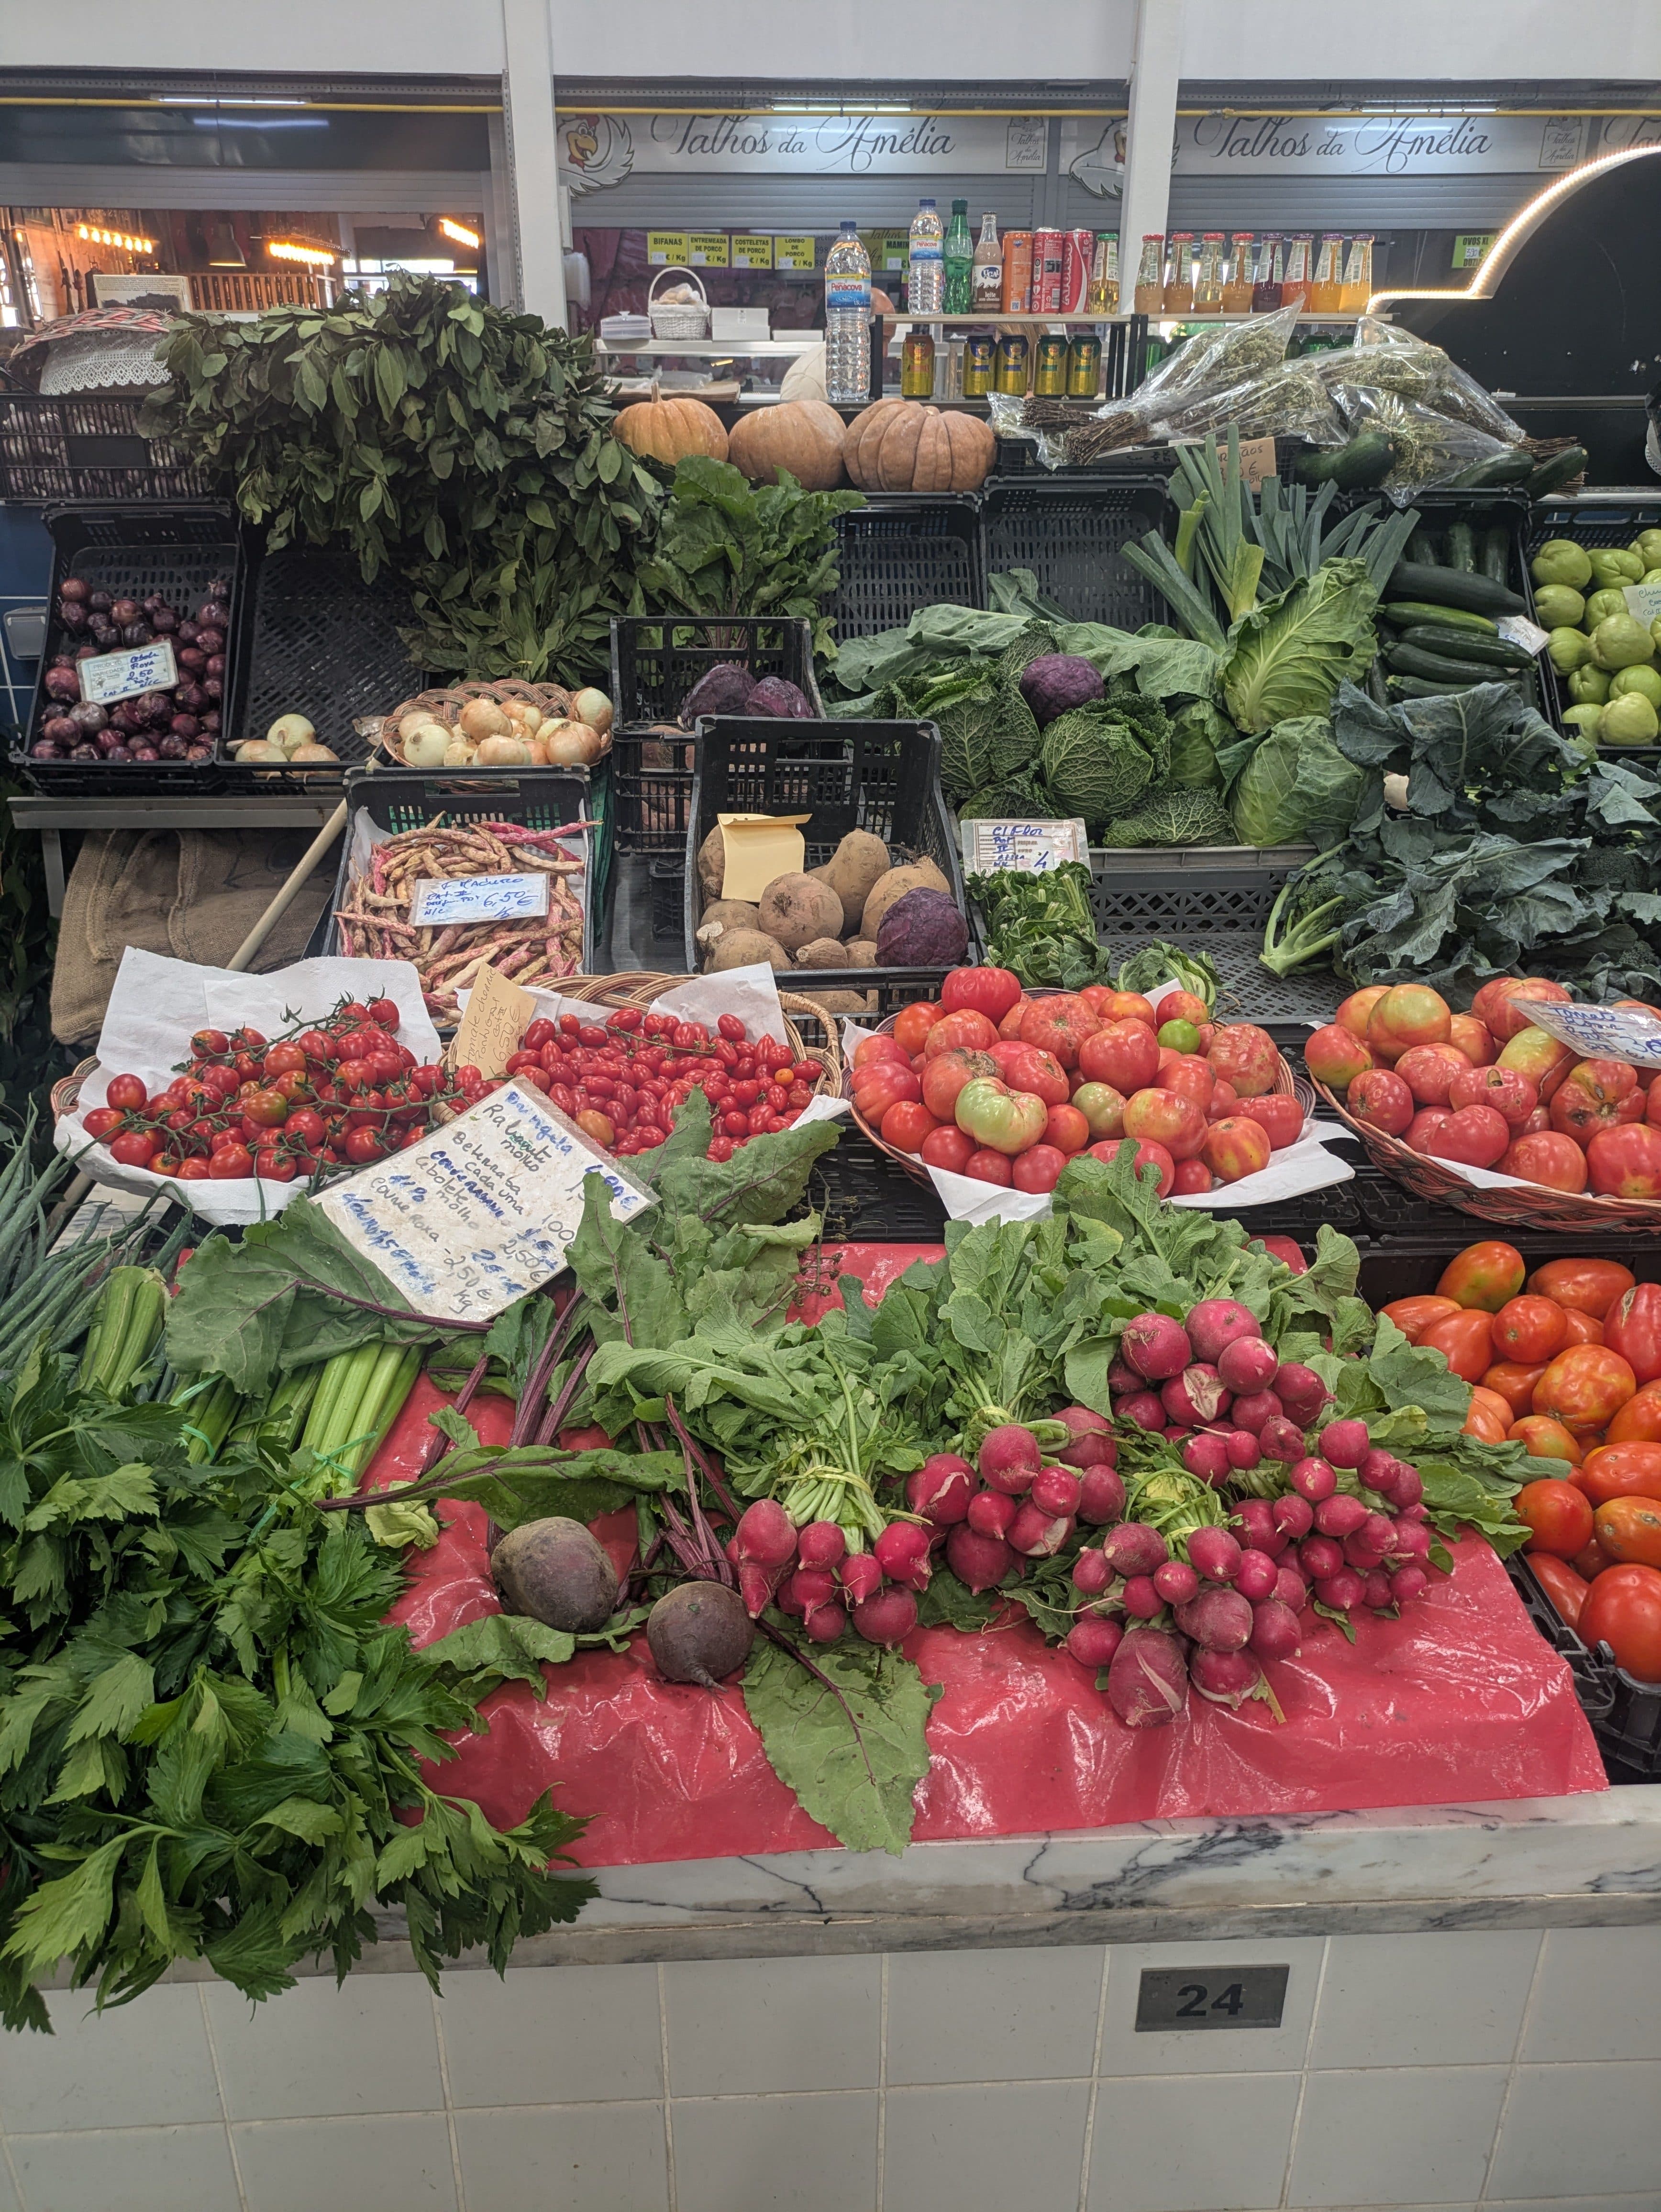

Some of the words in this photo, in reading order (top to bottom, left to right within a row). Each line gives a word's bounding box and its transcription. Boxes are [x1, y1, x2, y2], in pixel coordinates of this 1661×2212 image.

[651, 115, 772, 155] Talhos
[778, 125, 808, 153] da
[815, 116, 956, 171] Amélia
[1194, 117, 1312, 157] Talhos
[1317, 130, 1346, 156] da
[1352, 117, 1492, 173] Amélia
[1463, 237, 1480, 245] OVOS
[1482, 237, 1488, 245] XL
[93, 660, 122, 669] PRODUTO
[92, 666, 125, 677] VARIEDADE
[530, 1270, 549, 1283] €
[1176, 1983, 1244, 2017] 24
